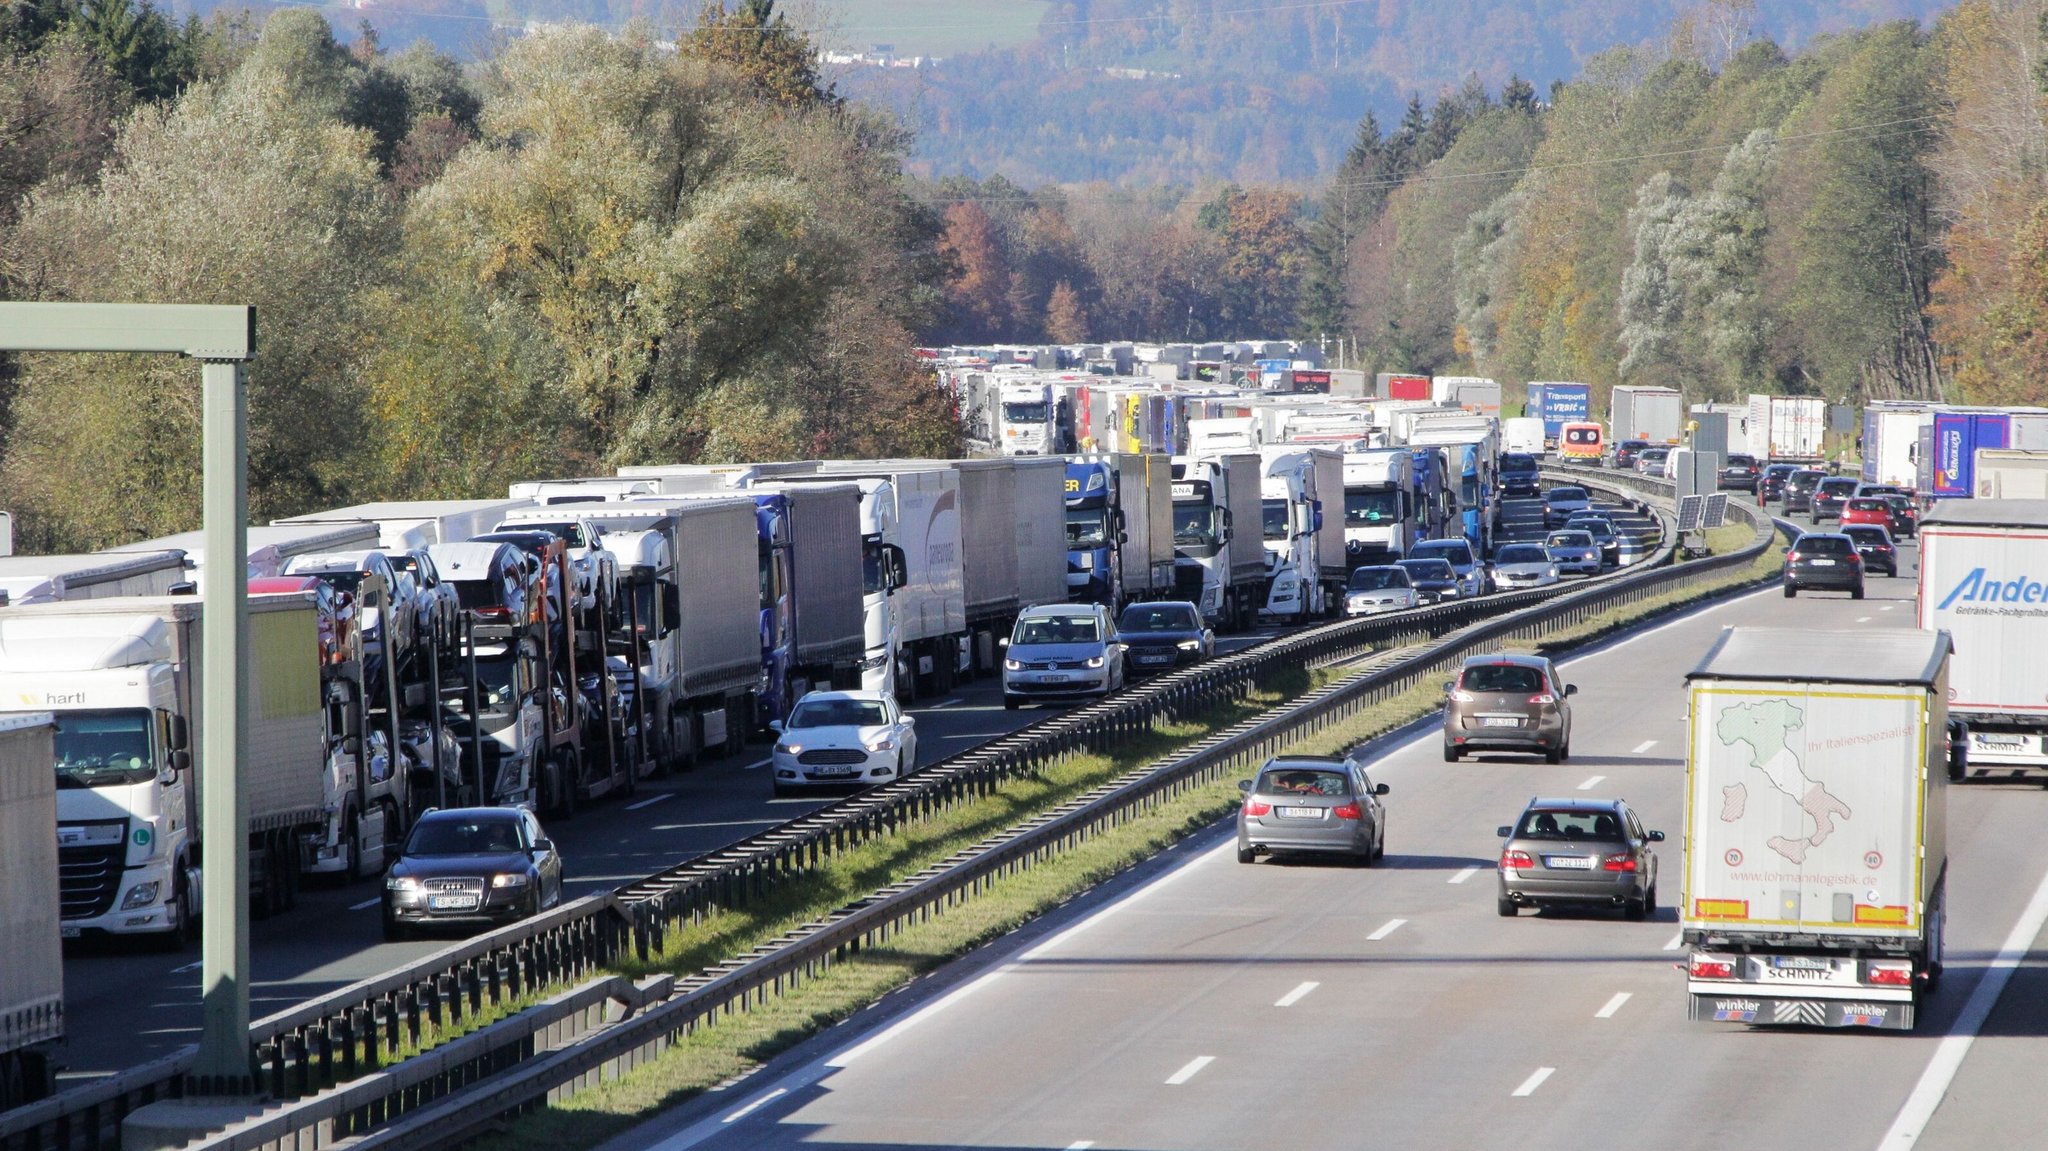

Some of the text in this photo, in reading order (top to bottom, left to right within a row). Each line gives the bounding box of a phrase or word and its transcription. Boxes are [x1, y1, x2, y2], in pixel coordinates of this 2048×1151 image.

[46, 692, 86, 704] hartl
[1808, 741, 1822, 753] Ihr
[1768, 968, 1833, 981] SCHMITZ
[1715, 999, 1761, 1011] winkler
[1842, 1003, 1888, 1017] winkler
